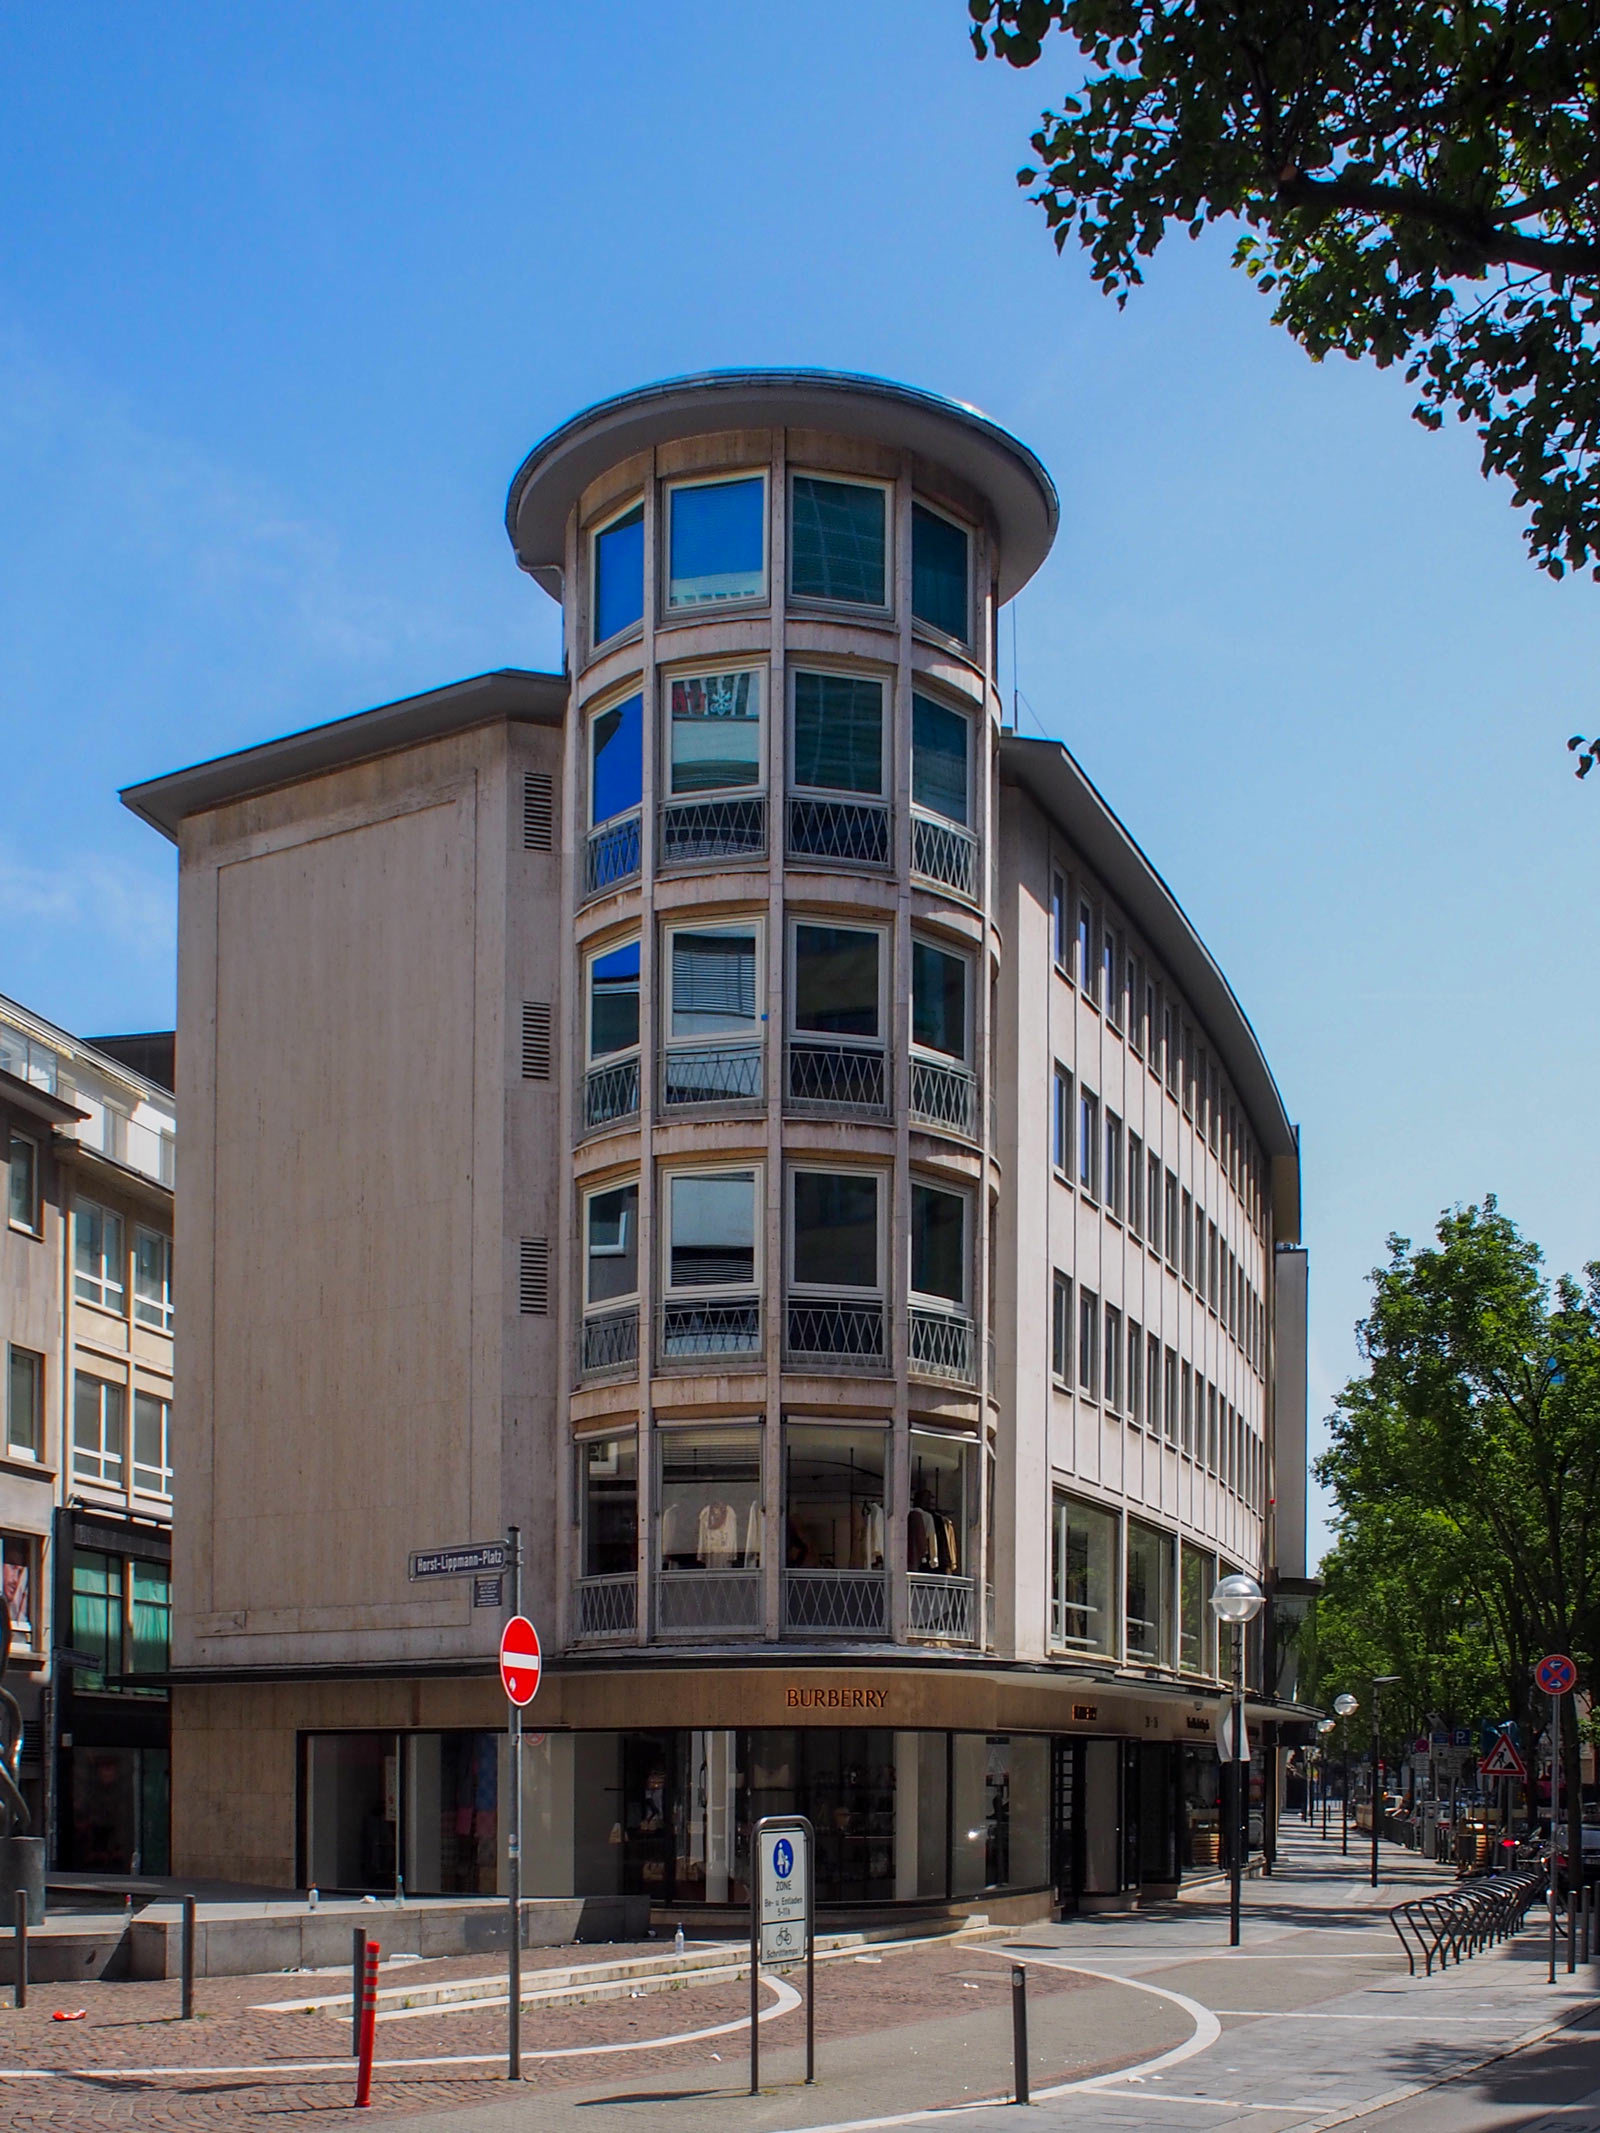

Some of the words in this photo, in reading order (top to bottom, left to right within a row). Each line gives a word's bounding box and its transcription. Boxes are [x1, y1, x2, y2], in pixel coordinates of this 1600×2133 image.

[417, 1550, 502, 1573] Horst-Lippmann-Platz
[787, 1689, 888, 1708] BURBERRY
[775, 1880, 792, 1892] ZONE
[781, 1896, 803, 1906] Entladen
